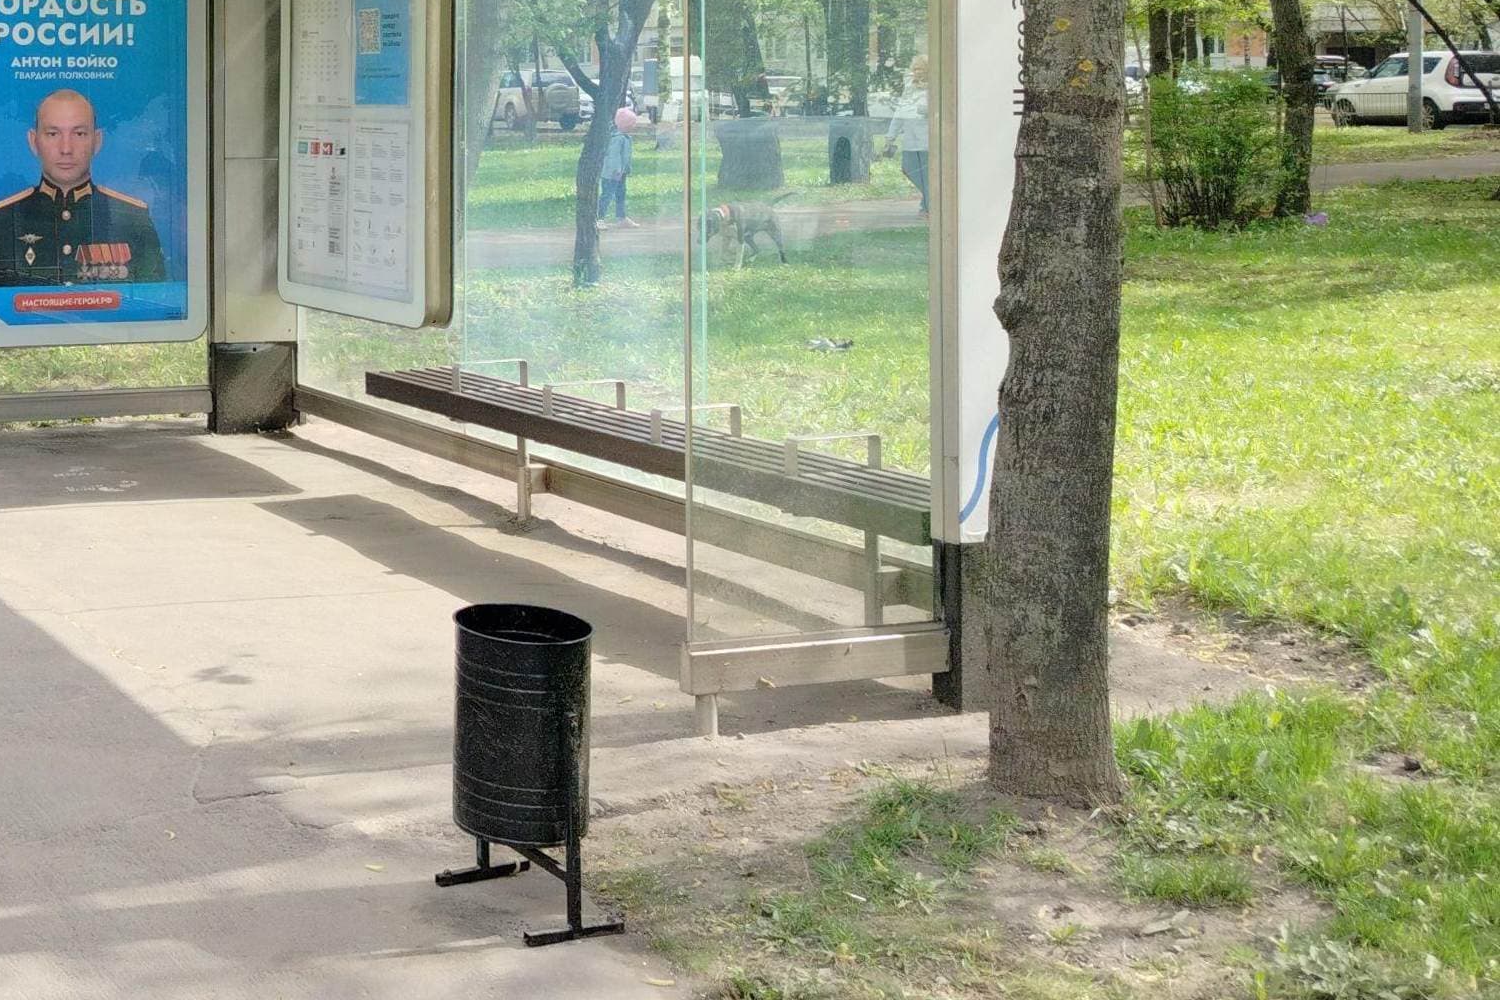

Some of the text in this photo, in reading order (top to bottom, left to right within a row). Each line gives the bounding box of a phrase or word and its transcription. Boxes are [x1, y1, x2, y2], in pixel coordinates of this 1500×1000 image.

[11, 53, 118, 68] АНТОН БОЙКО
[14, 71, 115, 80] ГВАРДИИ ПОЛКОВНИК
